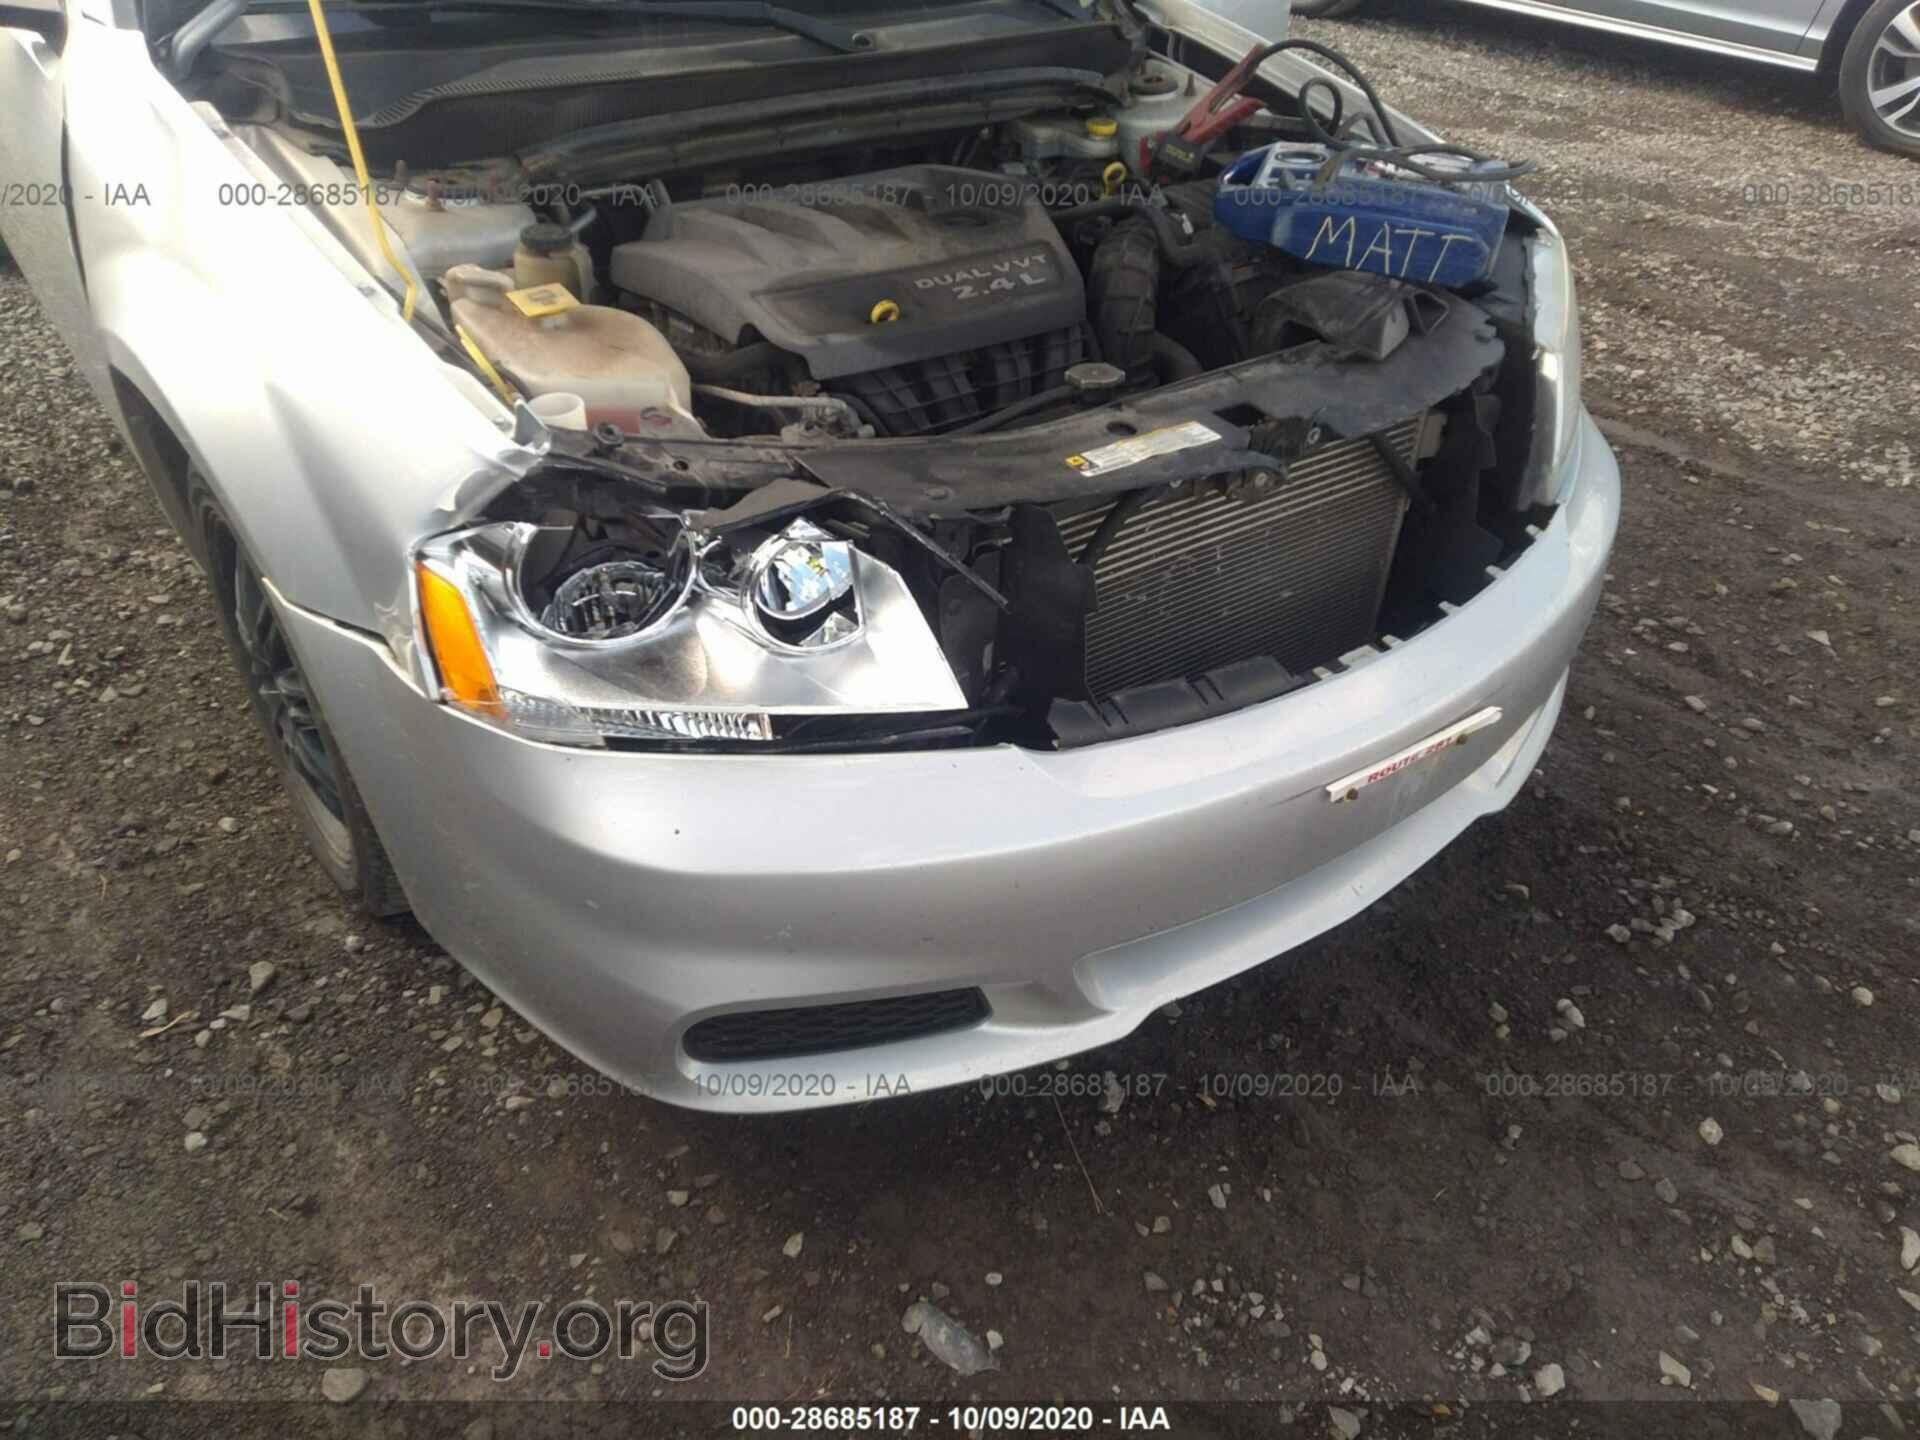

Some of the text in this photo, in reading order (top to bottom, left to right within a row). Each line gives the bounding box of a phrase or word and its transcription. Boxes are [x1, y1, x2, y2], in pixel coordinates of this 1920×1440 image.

[914, 253, 1047, 290] DUAL VVT
[1304, 216, 1474, 284] MATT
